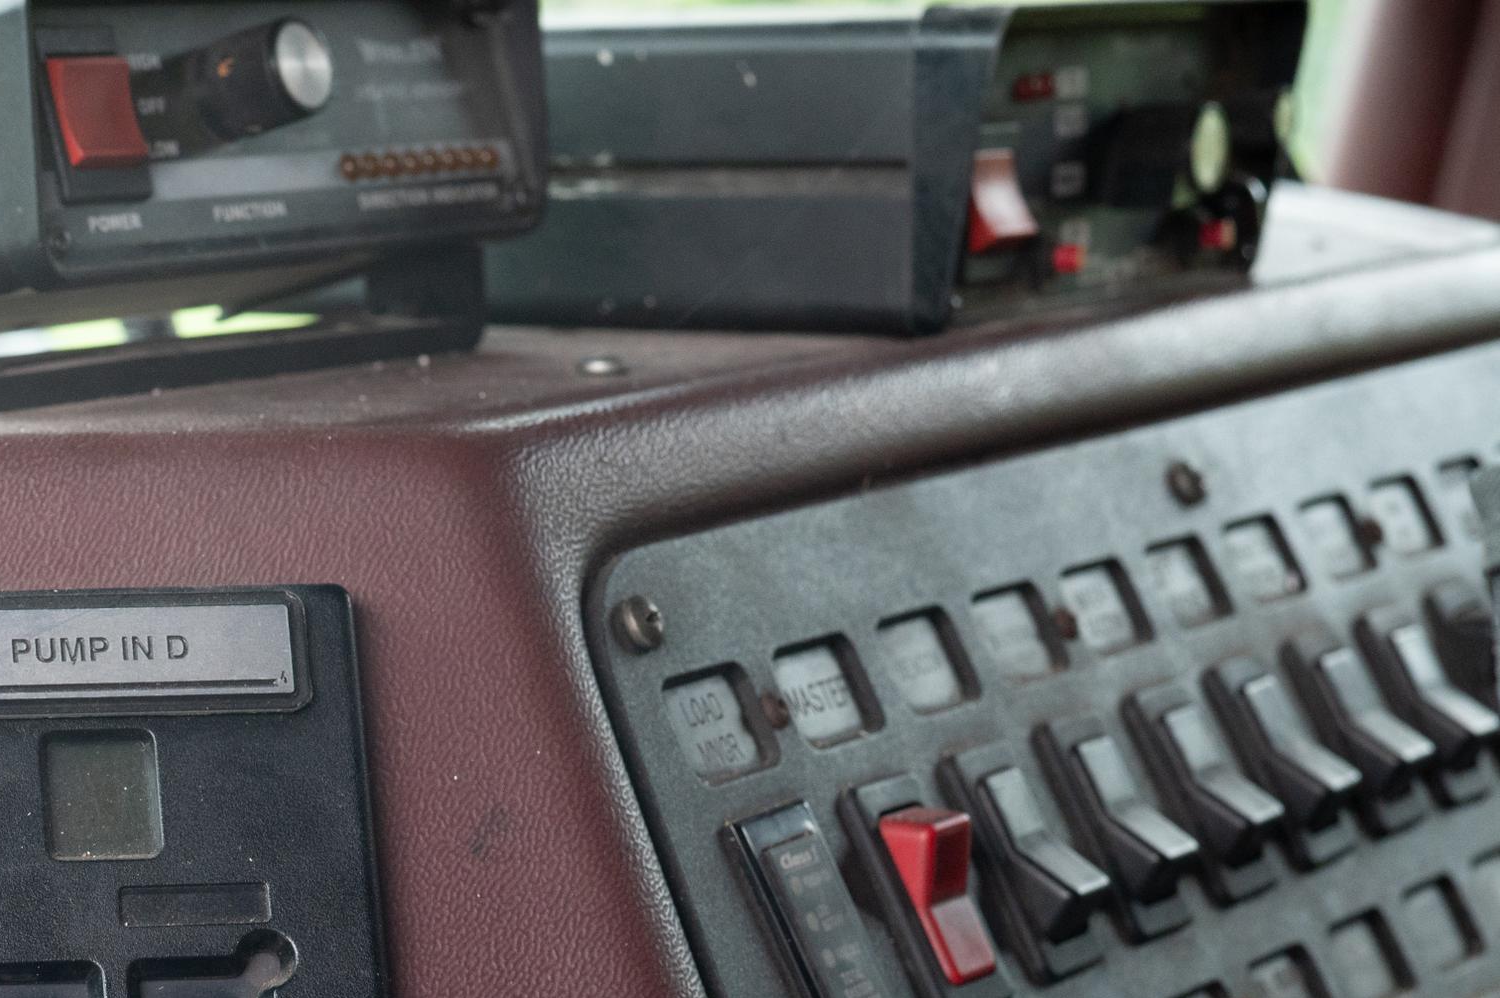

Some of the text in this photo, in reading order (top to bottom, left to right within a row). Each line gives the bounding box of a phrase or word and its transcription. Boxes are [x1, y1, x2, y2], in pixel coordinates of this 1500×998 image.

[87, 212, 142, 233] POWER
[212, 202, 287, 222] FUNCTION
[11, 634, 189, 665] PUMP IN D
[679, 691, 724, 728] LOAD
[783, 675, 847, 717] MASTE
